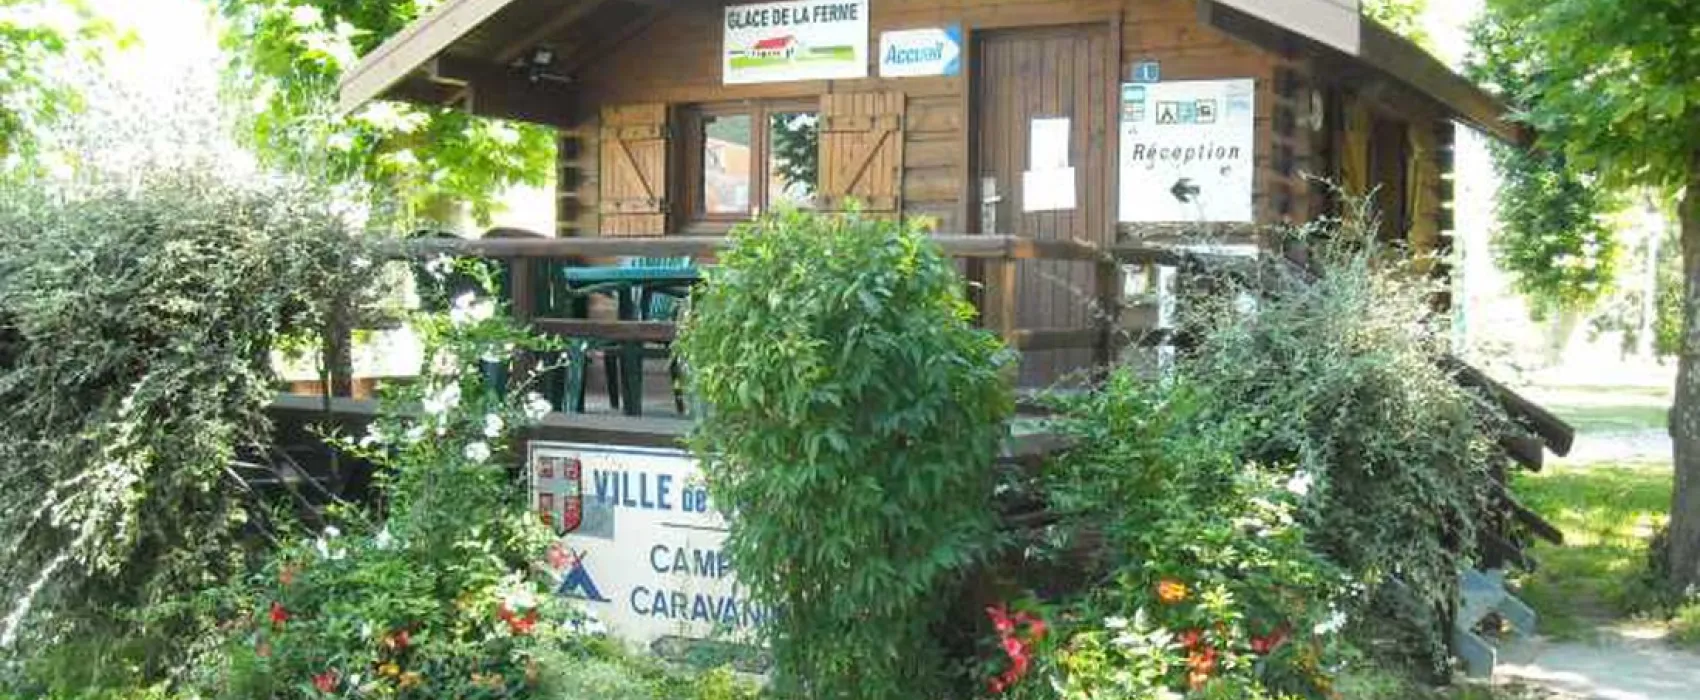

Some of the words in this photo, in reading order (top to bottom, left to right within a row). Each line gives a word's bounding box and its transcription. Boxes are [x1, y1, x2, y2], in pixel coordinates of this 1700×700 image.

[727, 9, 769, 29] GLACE
[772, 8, 789, 25] DE
[793, 7, 810, 24] LA
[813, 3, 859, 23] FERME
[884, 41, 944, 65] Accueil
[1132, 142, 1241, 165] Réception
[593, 469, 672, 510] VILLE
[650, 544, 731, 580] CAMP
[630, 586, 770, 628] CARAVAN
